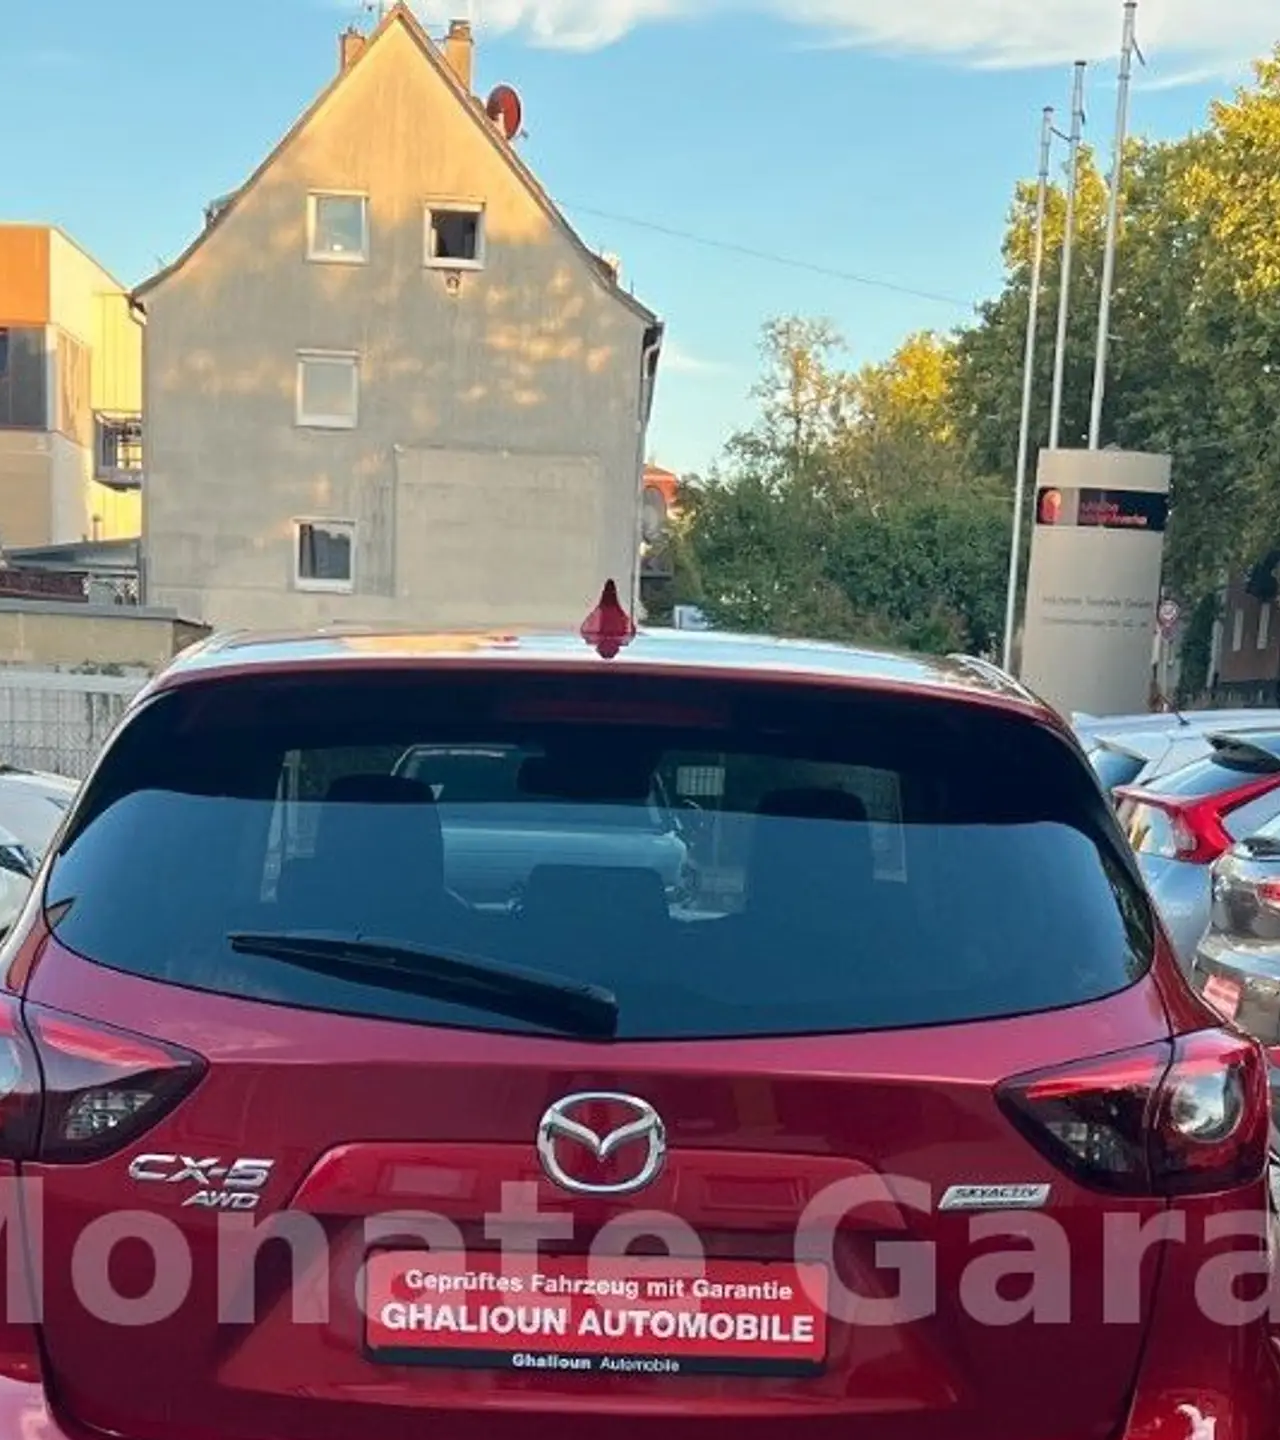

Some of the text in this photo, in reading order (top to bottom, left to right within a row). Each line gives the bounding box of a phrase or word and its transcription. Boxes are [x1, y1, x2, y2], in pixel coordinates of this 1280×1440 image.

[129, 1154, 275, 1187] CX-5
[180, 1190, 260, 1208] AWD
[405, 1269, 794, 1301] Geprüftes Fahrzeug mit Garantie
[380, 1302, 815, 1343] GHALIOUN AUTOMOBILE
[512, 1353, 680, 1373] Ghalioun Automobile
